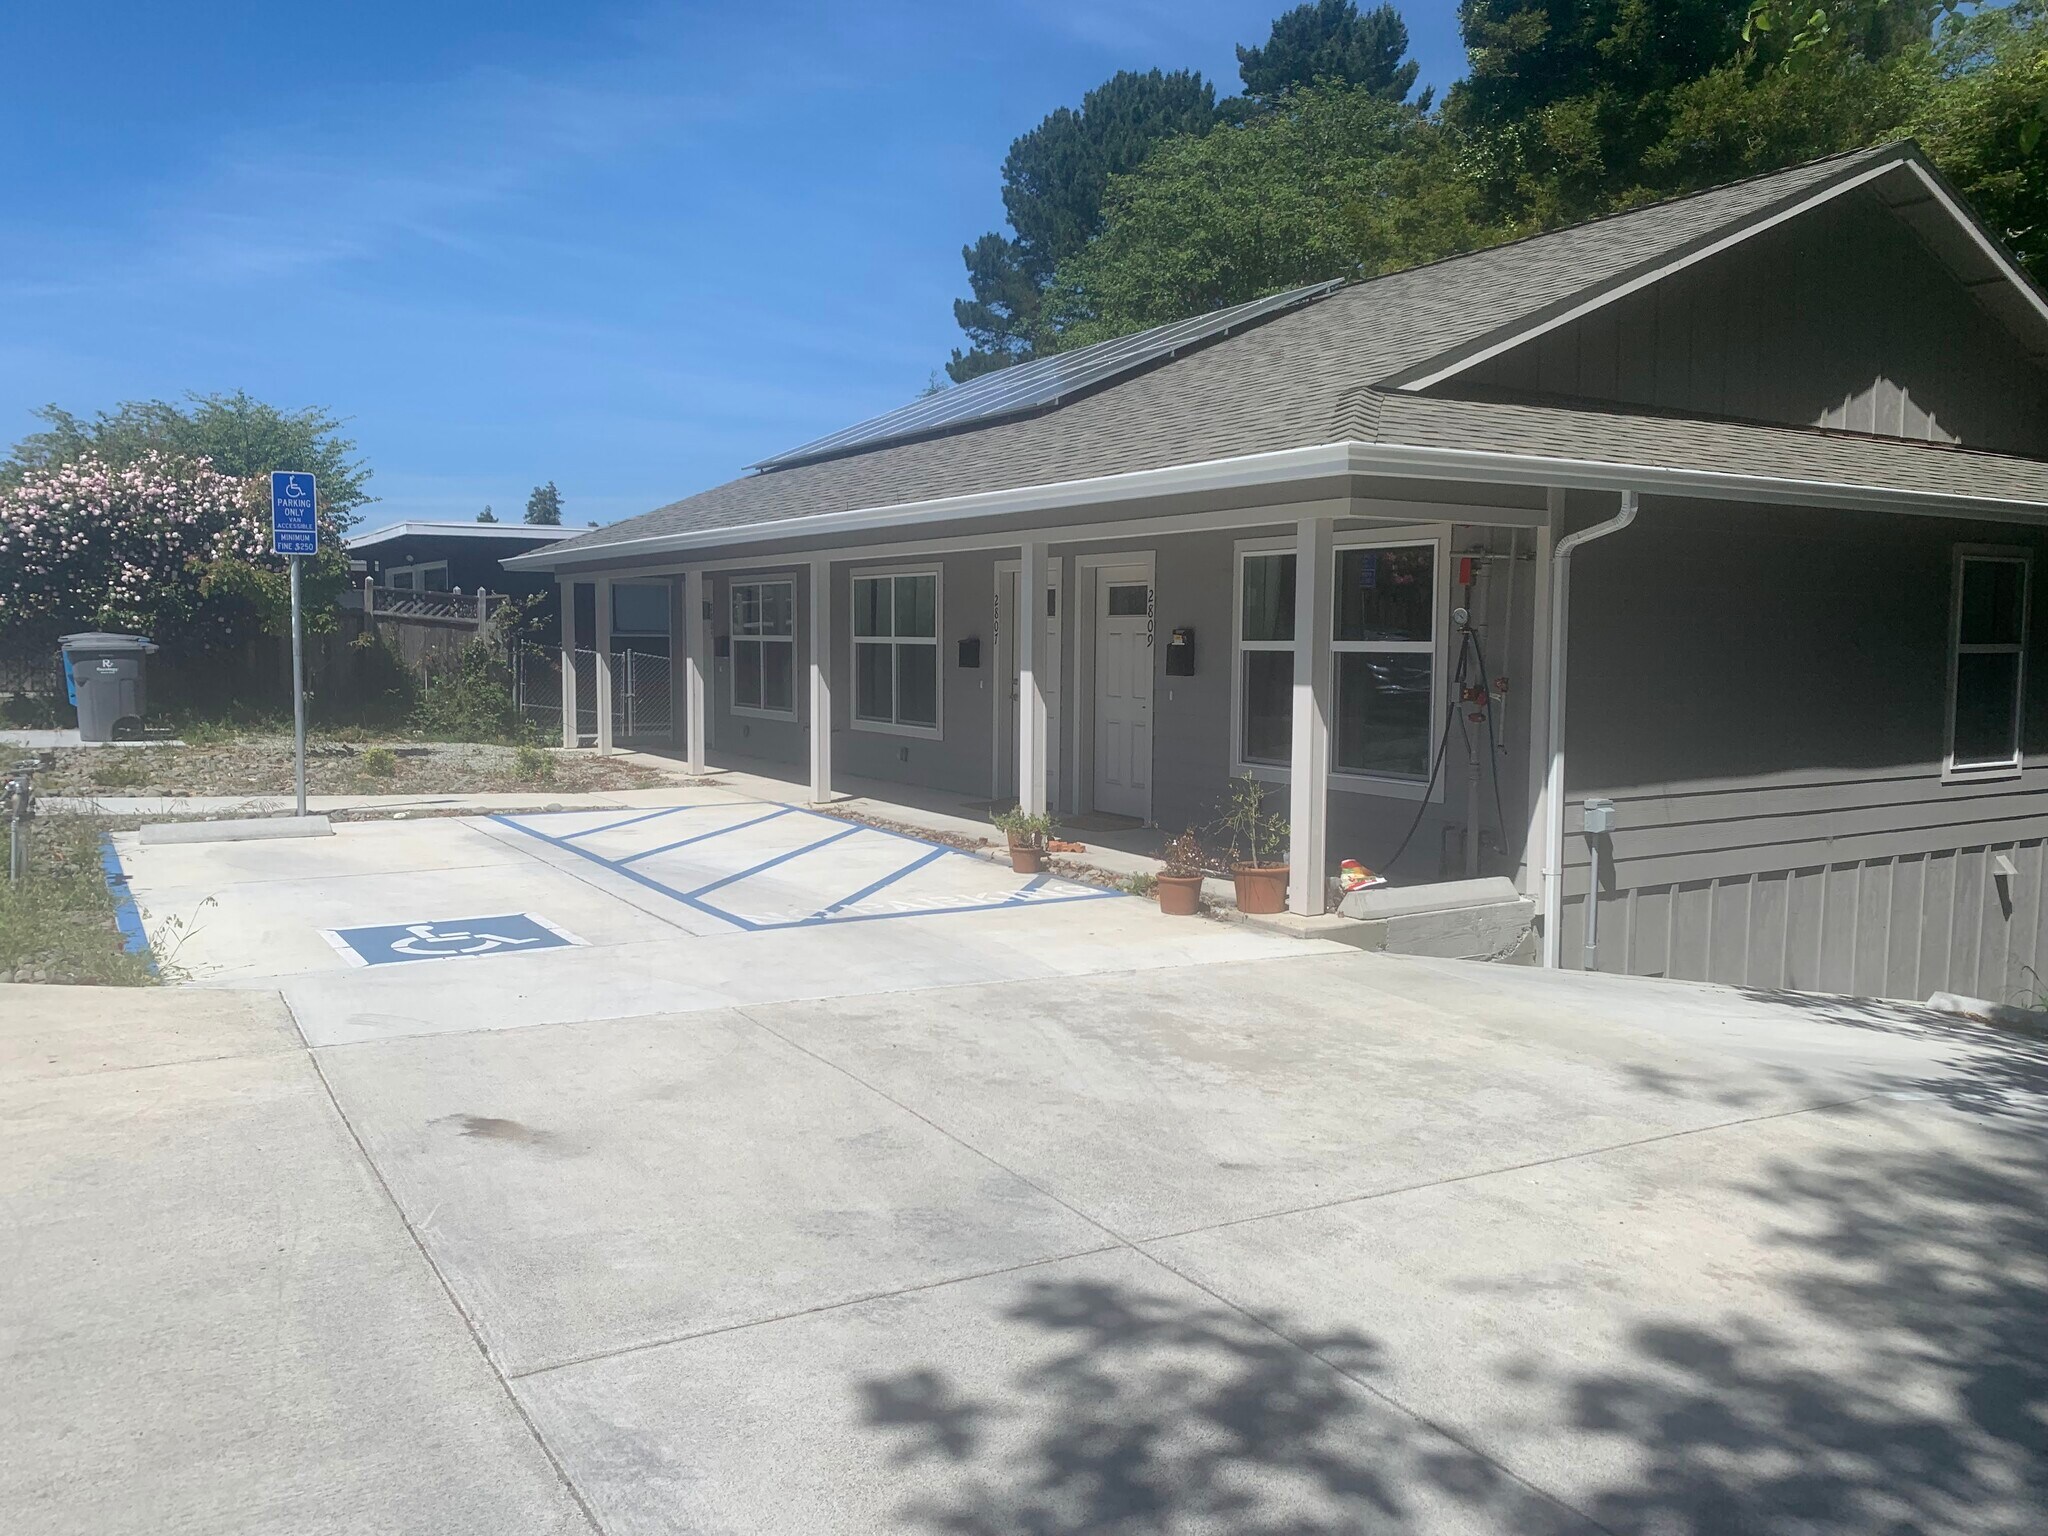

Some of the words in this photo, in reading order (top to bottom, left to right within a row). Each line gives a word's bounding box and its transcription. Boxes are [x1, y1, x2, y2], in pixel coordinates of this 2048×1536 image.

[277, 498, 311, 508] PARKING
[284, 508, 304, 517] ONLY
[277, 542, 293, 550] FINE
[294, 542, 314, 551] $250
[1146, 589, 1154, 648] 2809
